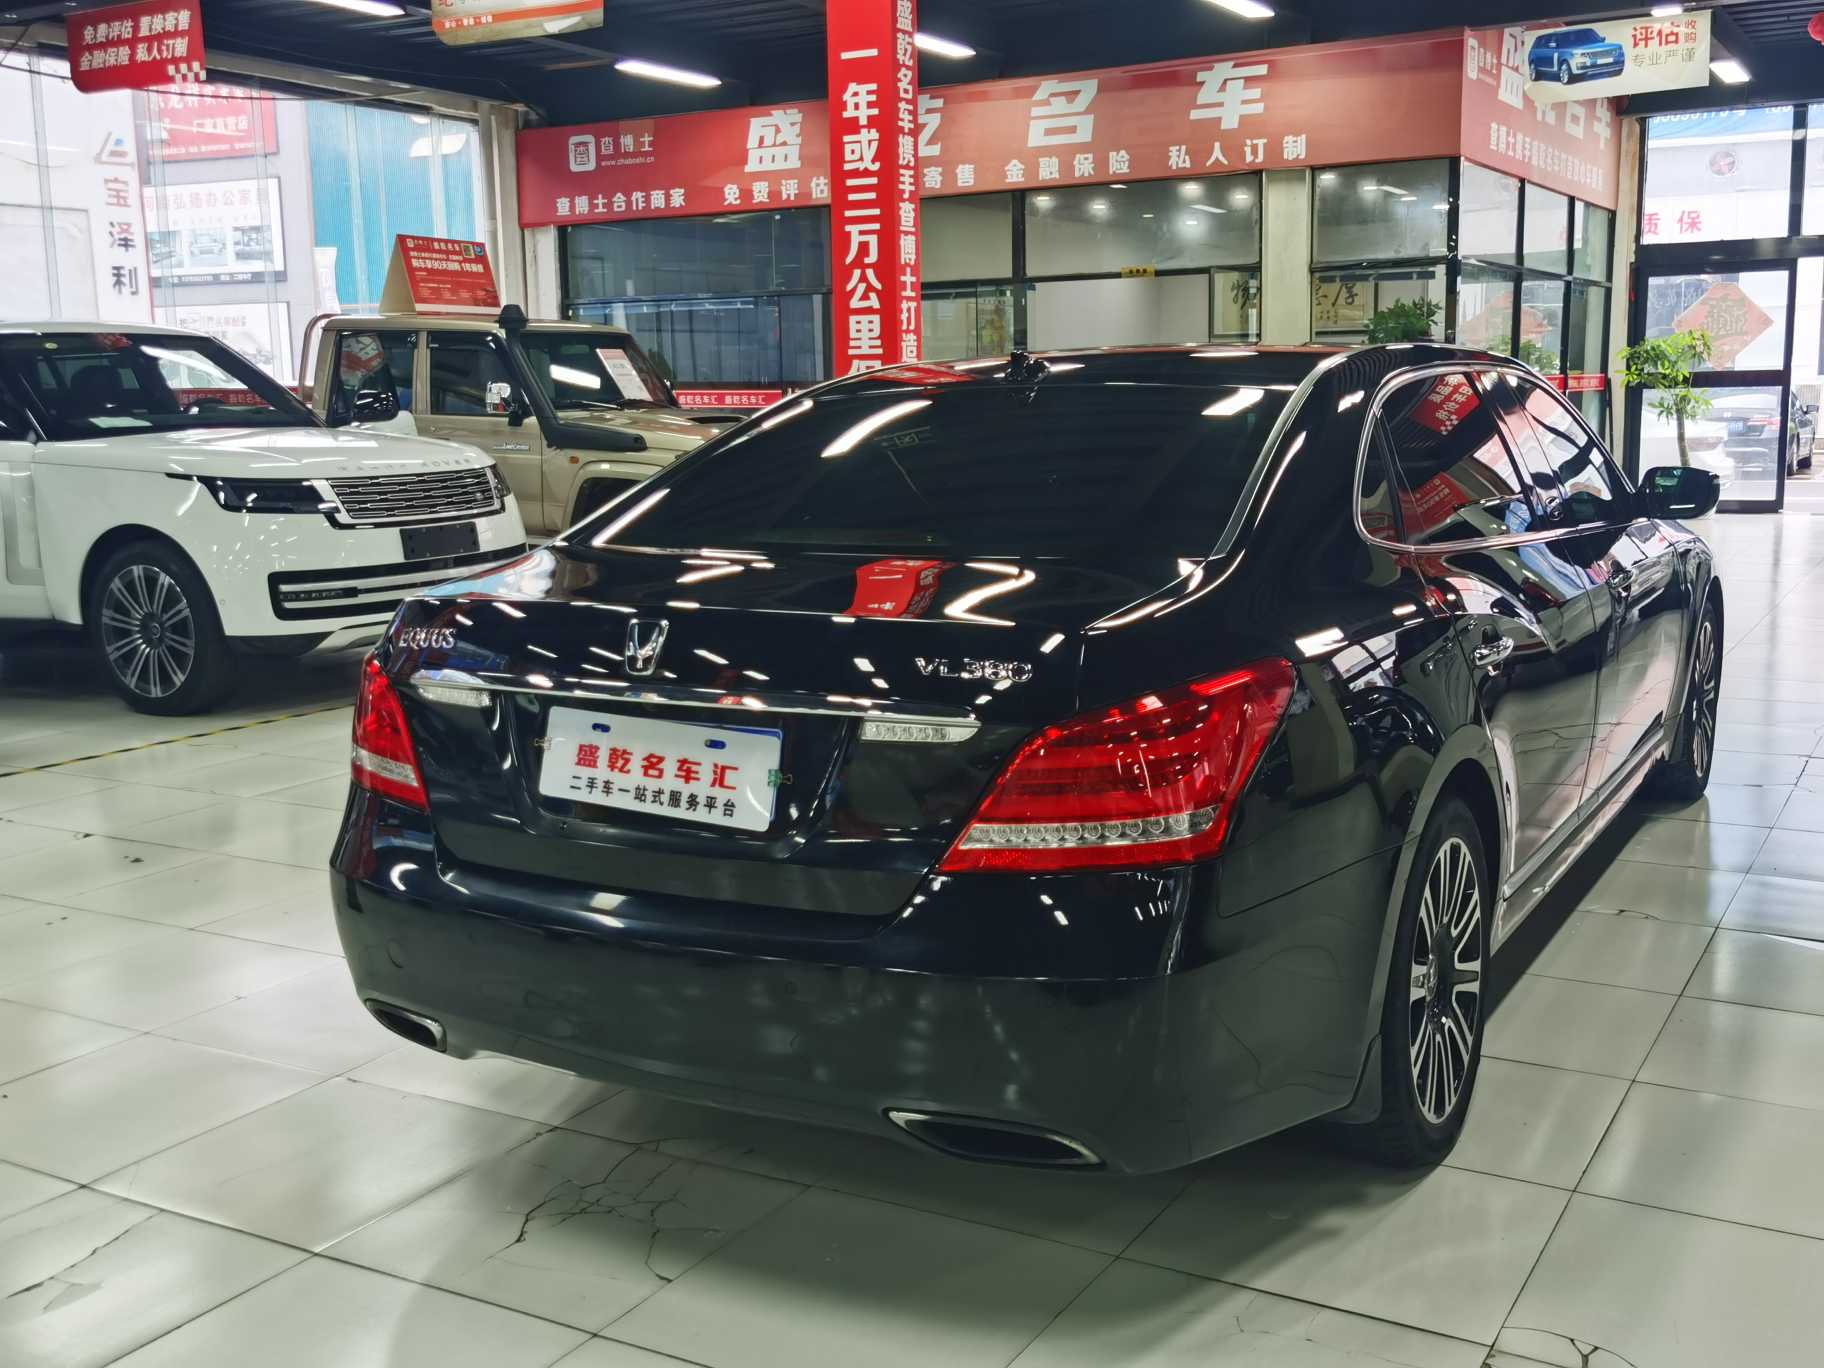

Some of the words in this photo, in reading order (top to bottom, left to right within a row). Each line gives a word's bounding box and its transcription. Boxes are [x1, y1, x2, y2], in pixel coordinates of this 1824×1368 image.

[83, 19, 134, 45] 免费评估
[138, 9, 191, 37] 置换寄售
[1631, 21, 1681, 48] 评估
[80, 45, 131, 70] 金融保险
[136, 36, 189, 63] 私人订制
[1631, 47, 1696, 67] 专业严谨
[599, 132, 654, 154] 查博士
[723, 176, 829, 206] 免费评估
[1004, 149, 1131, 183] 金融保险
[1168, 133, 1307, 169] 私人订制
[556, 188, 686, 216] 查博士合作商家
[103, 176, 140, 296] 宝泽利
[399, 627, 457, 650] EQUUS
[915, 656, 1033, 683] VL380
[574, 743, 740, 793] 盛乾名车汇
[569, 774, 738, 819] 二手车一站式服务平台
